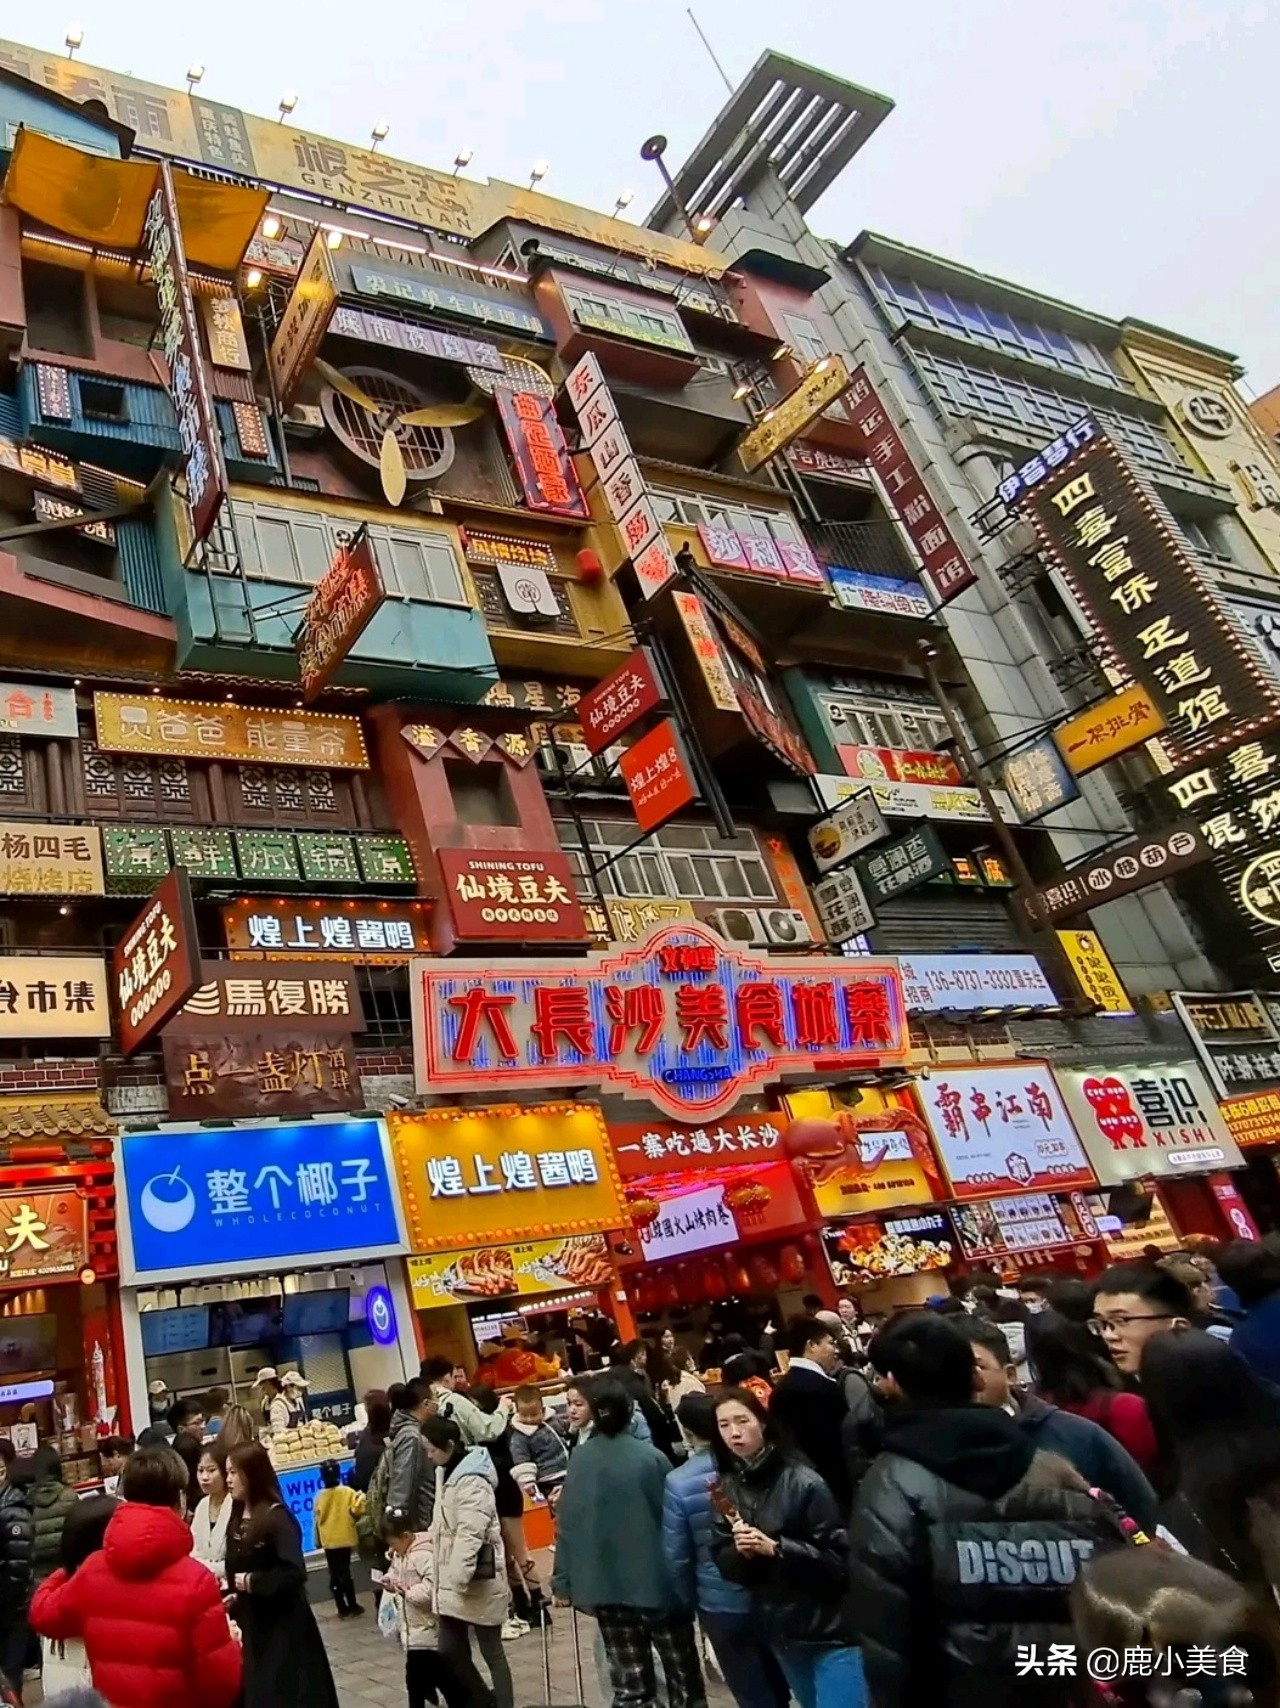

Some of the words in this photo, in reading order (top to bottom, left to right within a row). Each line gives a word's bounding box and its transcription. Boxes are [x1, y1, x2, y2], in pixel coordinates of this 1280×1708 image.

[302, 172, 472, 231] GENZHILIAN
[846, 378, 966, 589] 鸿运手工粉面馆
[1052, 472, 1231, 731] 四喜富侨足道馆
[589, 673, 647, 729] 仙境豆夫
[245, 716, 347, 756] 能量茶
[1168, 742, 1277, 809] 四喜
[1, 832, 92, 862] 杨四毛
[468, 860, 514, 871] SHINING
[515, 861, 545, 872] TOFU
[1089, 833, 1193, 888] 冰糖葫芦
[456, 873, 572, 905] 仙境豆夫
[249, 914, 416, 949] 煌上煌酱鸭
[119, 913, 178, 1010] 仙境豆夫
[182, 1047, 325, 1097] 点一盏灯
[1130, 1077, 1208, 1128] 喜识
[617, 1123, 781, 1161] 一寨吃遍大长沙
[1152, 1127, 1217, 1147] XISHI
[206, 1158, 379, 1216] 整个椰子
[427, 1149, 599, 1197] 煌上煌酱鸭
